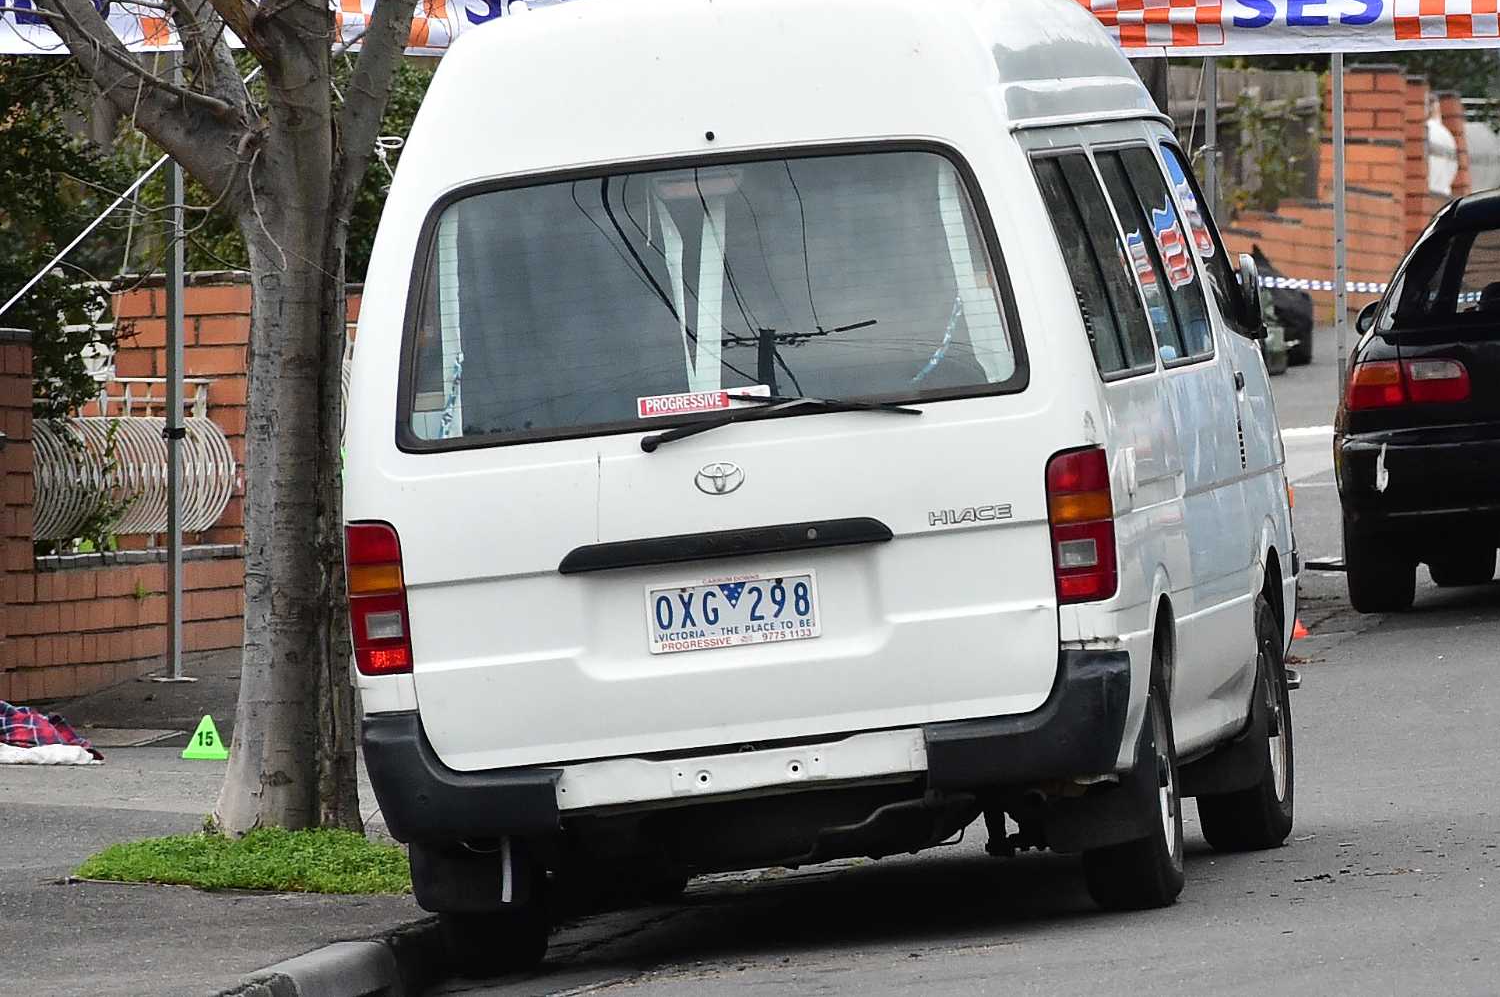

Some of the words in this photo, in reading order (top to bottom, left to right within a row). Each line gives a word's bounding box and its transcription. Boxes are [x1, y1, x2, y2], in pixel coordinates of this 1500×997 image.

[646, 392, 722, 413] PROGRESSIVE
[928, 503, 1012, 526] HIACE
[656, 591, 720, 630] OXG
[747, 581, 810, 622] 298
[659, 629, 705, 642] VICTORIA
[721, 626, 739, 636] THE
[745, 623, 775, 633] PLACE
[780, 620, 793, 629] TO
[800, 618, 811, 628] BE
[661, 636, 732, 651] PROGRESSIVE
[762, 630, 786, 641] 9775
[789, 628, 812, 638] 1133
[198, 731, 213, 746] 15
